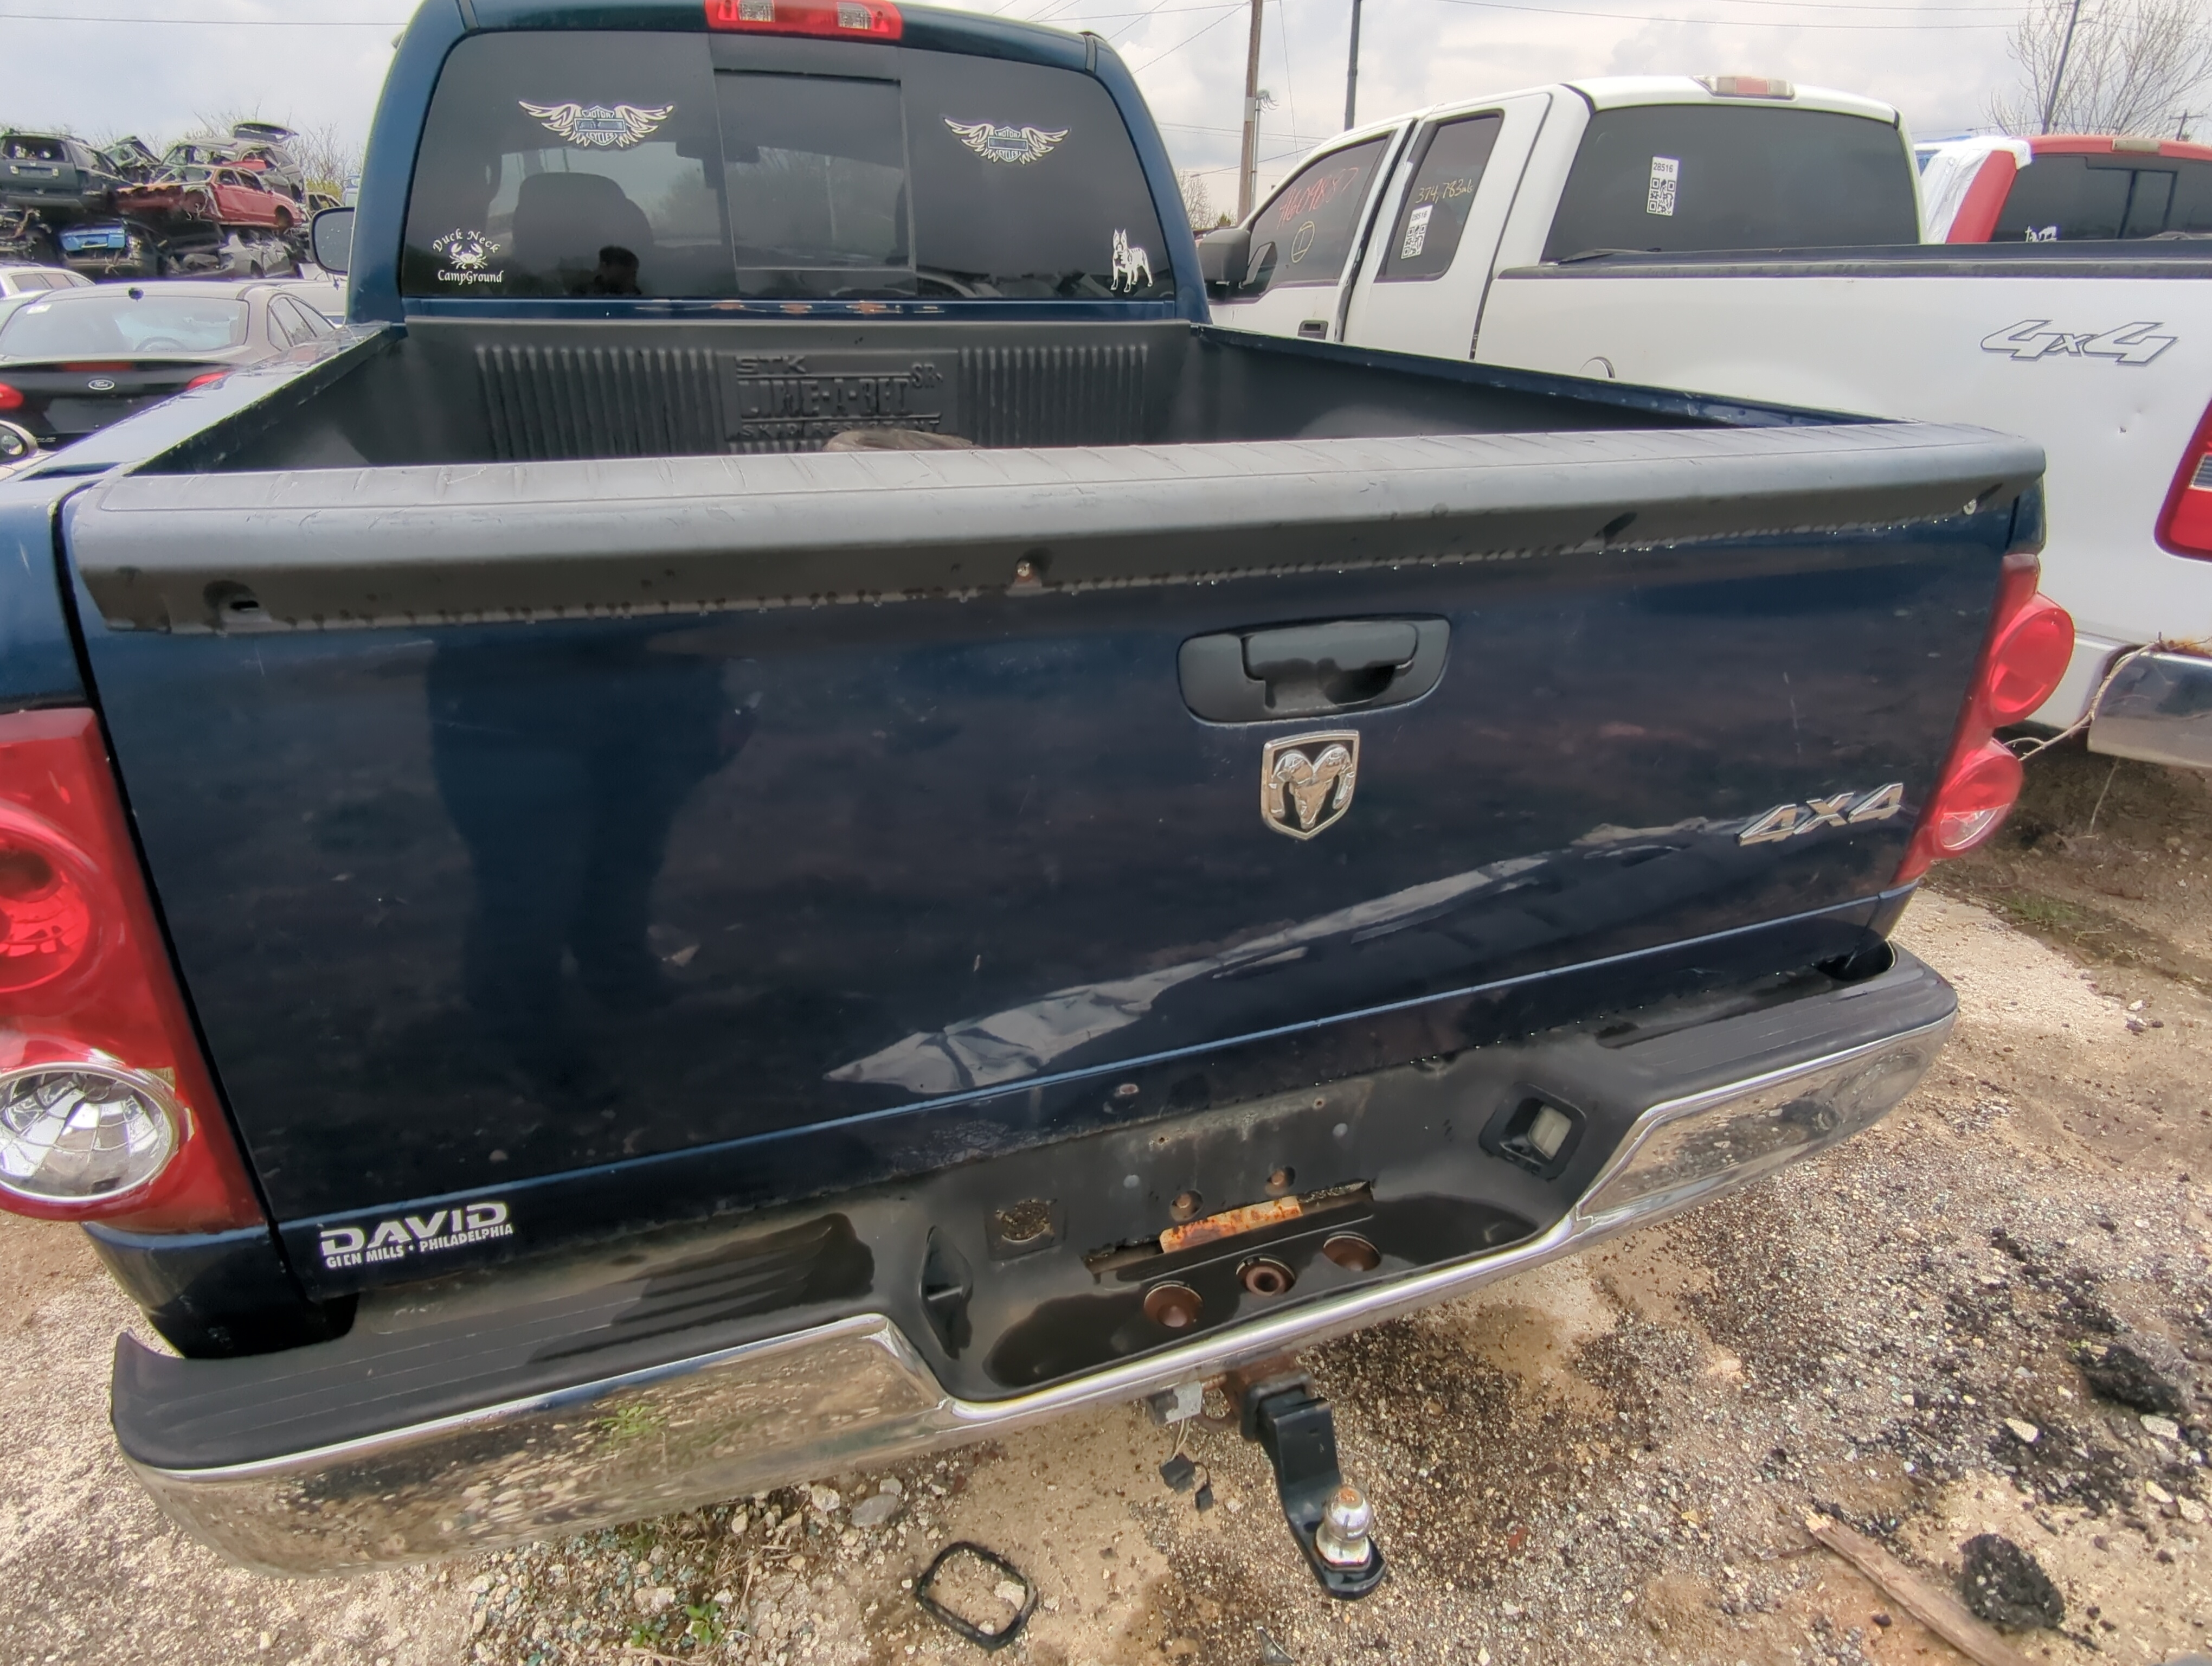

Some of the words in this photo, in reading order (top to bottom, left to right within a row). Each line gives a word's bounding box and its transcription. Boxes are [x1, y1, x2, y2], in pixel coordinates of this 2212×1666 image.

[586, 109, 611, 118] MOTOR
[589, 132, 614, 143] CYCLES
[998, 129, 1018, 138] MOTOR
[999, 150, 1018, 160] CYCLES
[1653, 162, 1674, 173] 28516
[433, 228, 463, 252] Duck
[466, 230, 500, 253] Neck
[320, 1202, 507, 1255] DAVID
[366, 1247, 404, 1262] MILLS
[419, 1223, 514, 1252] PHILADELPHIA
